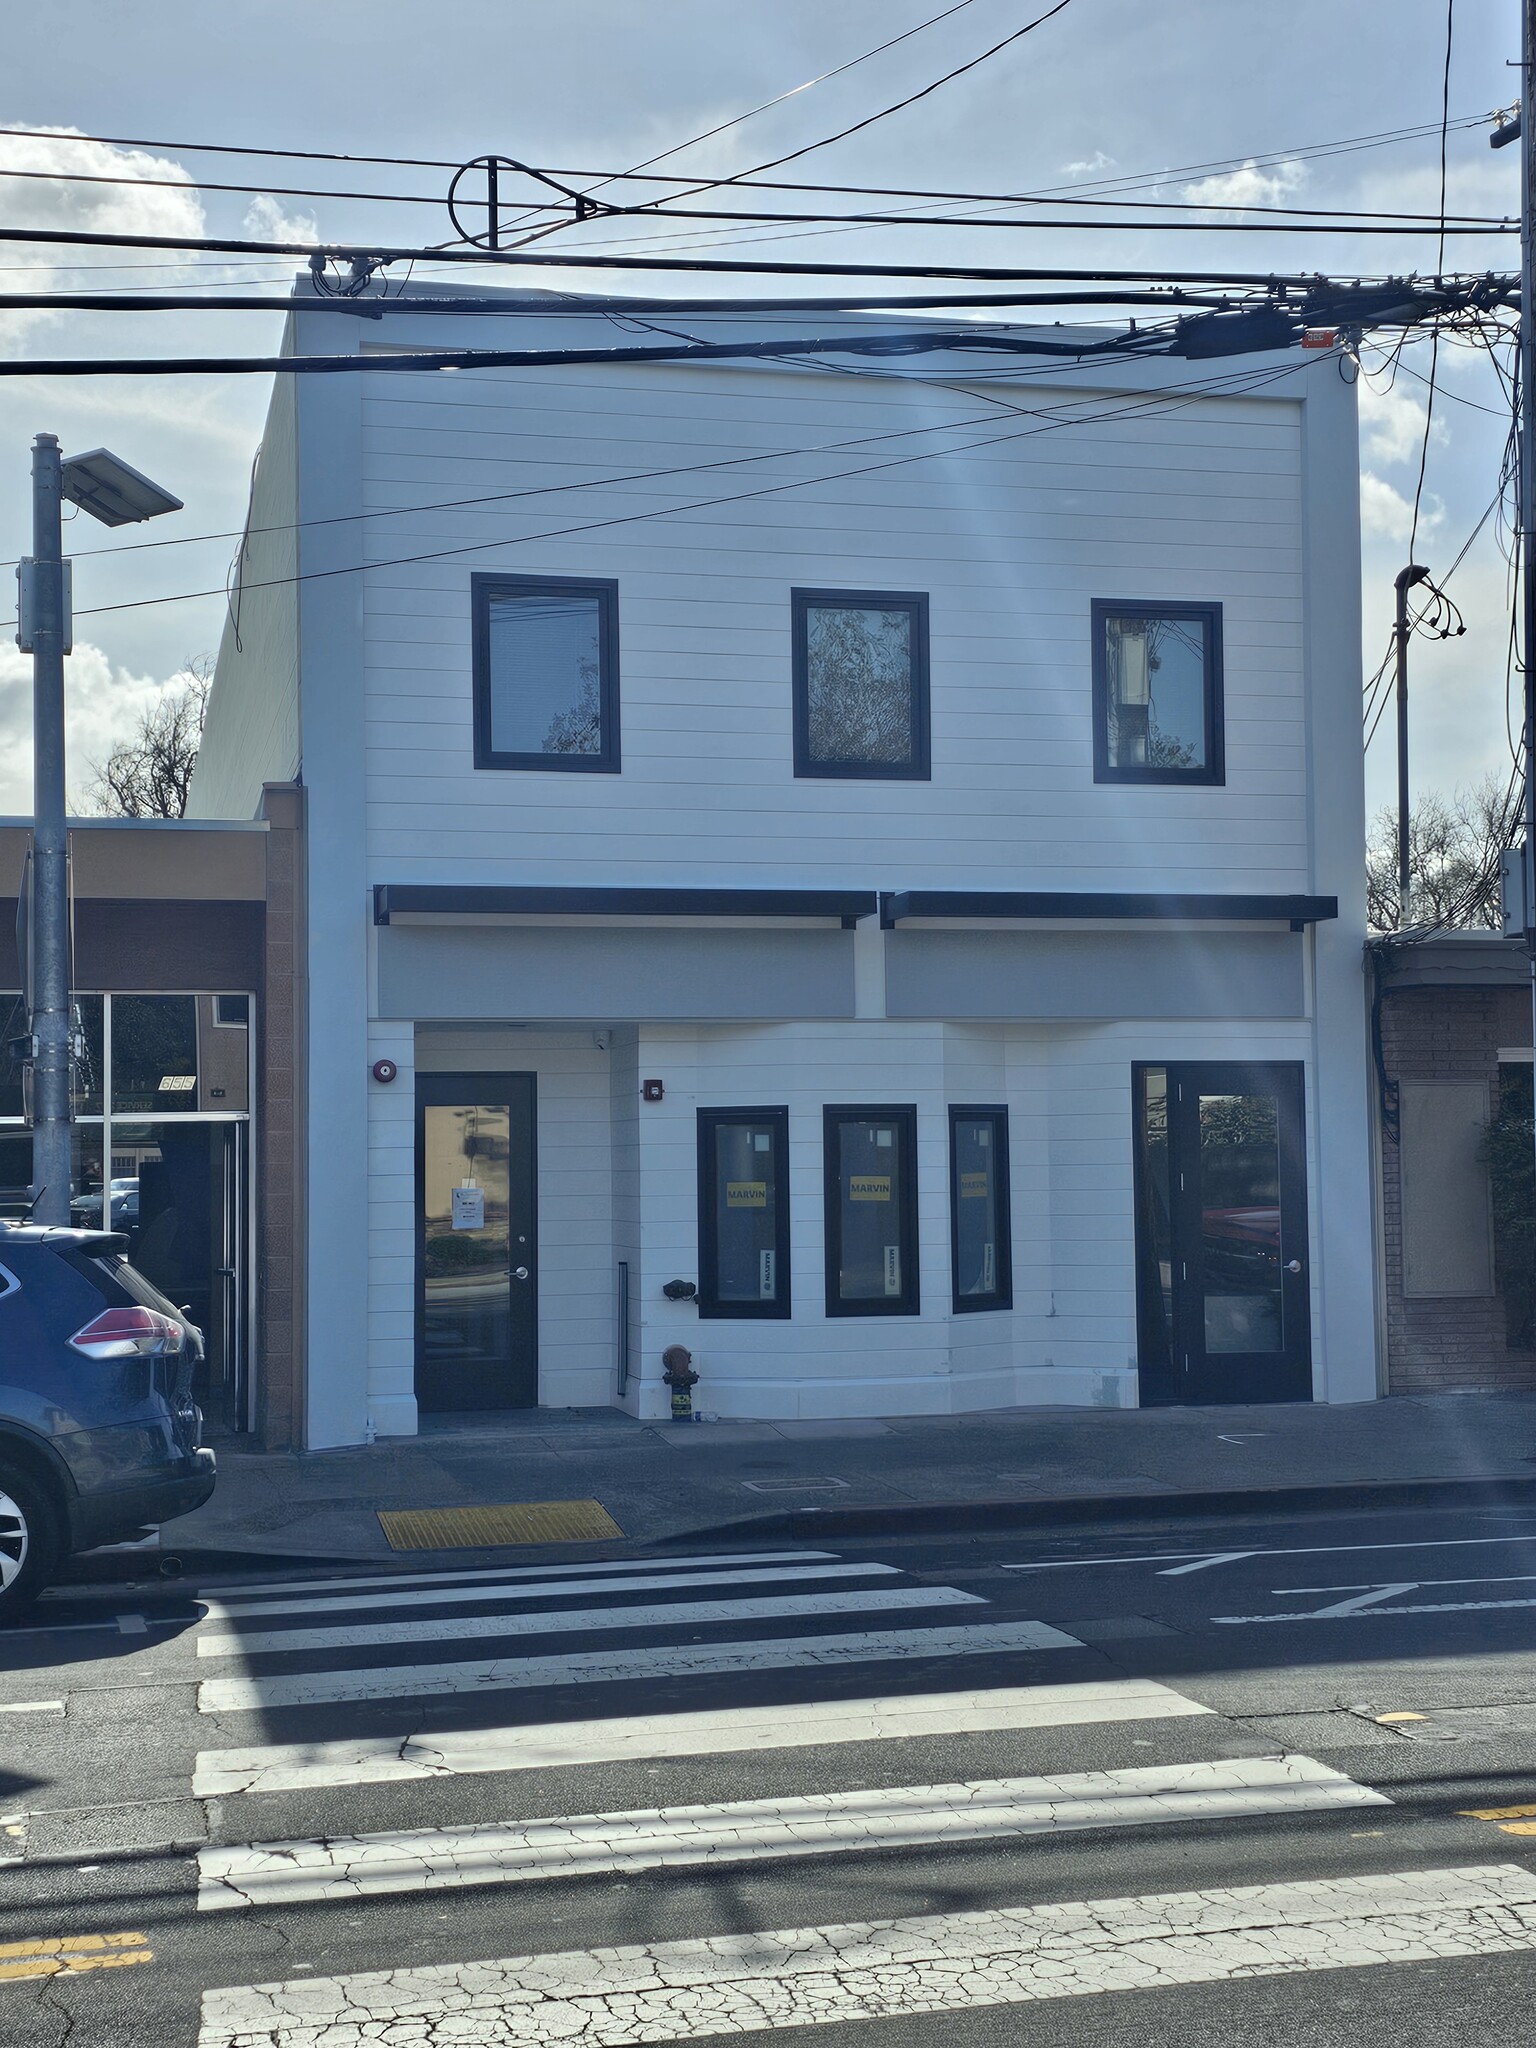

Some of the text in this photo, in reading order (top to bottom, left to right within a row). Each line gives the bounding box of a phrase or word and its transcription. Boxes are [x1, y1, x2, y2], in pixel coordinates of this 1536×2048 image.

[161, 1078, 193, 1089] 655
[851, 1184, 889, 1193] MARVIN
[728, 1190, 765, 1199] MARVIN
